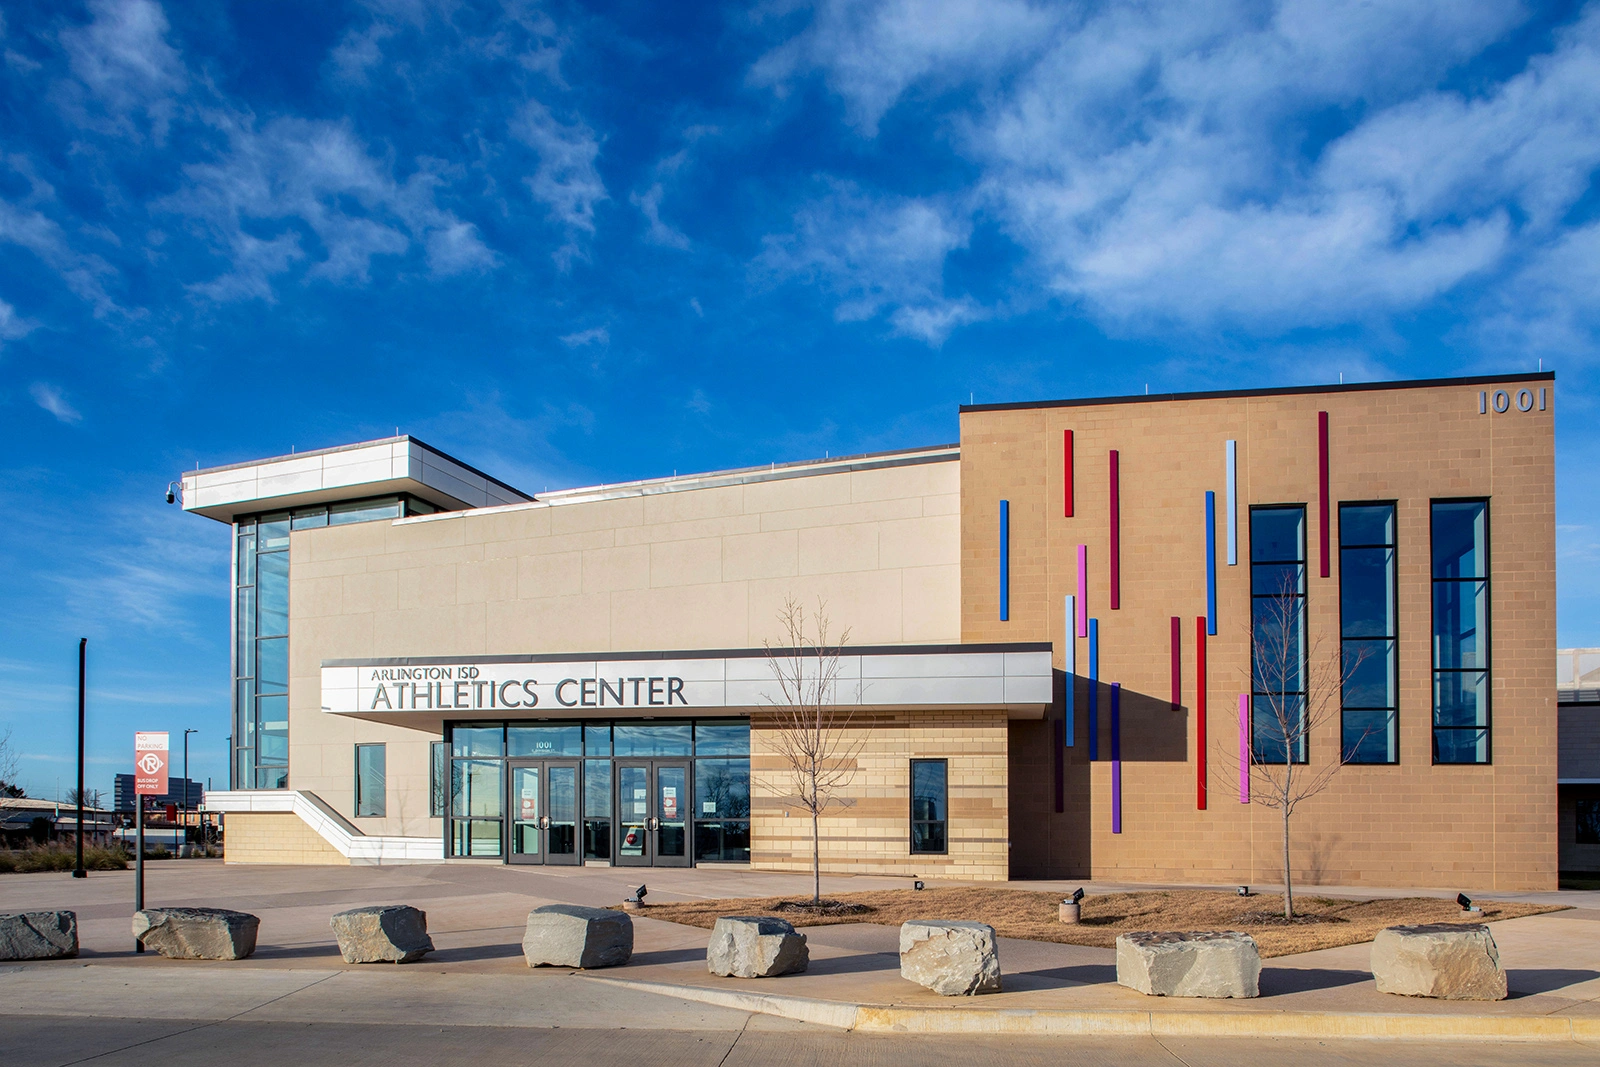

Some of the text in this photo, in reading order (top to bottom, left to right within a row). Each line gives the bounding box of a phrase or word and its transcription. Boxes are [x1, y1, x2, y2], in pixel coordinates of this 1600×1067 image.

[1479, 388, 1546, 414] 1001
[371, 666, 479, 681] ARLINGTON ISD
[371, 677, 689, 709] ATHLETICS CENTER
[536, 741, 552, 749] 1001
